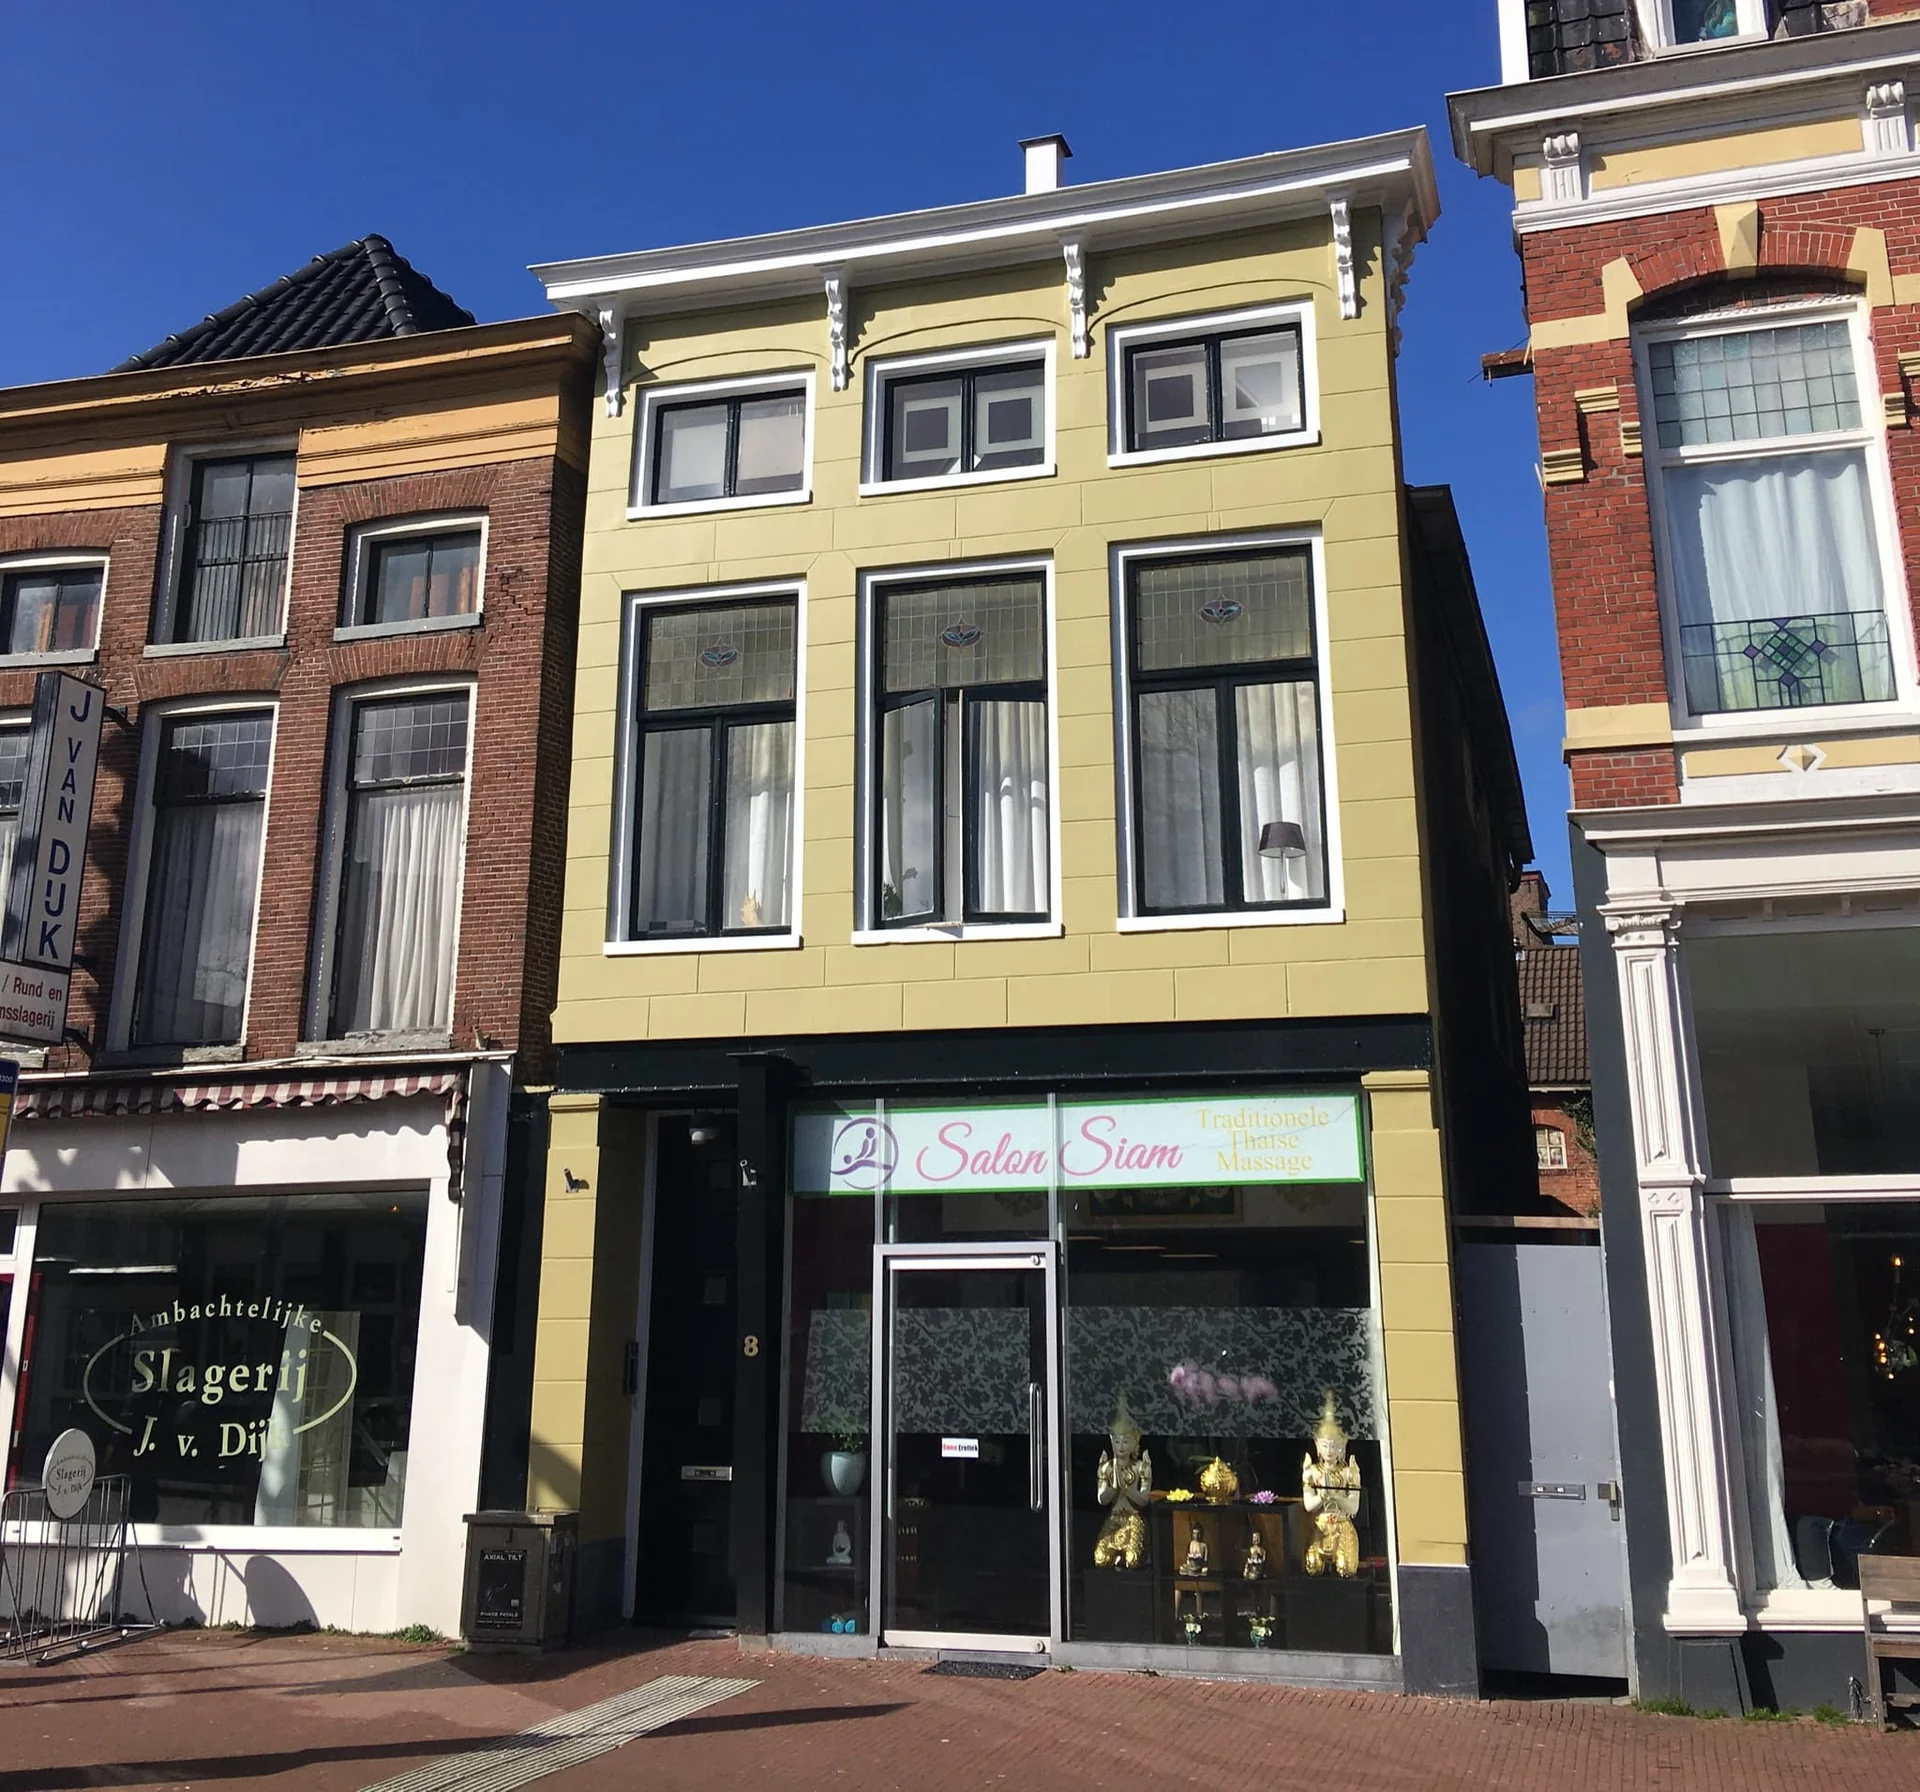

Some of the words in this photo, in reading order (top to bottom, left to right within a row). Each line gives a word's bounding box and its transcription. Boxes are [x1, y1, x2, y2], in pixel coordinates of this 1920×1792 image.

[70, 690, 91, 723] J
[57, 736, 83, 824] VAN
[38, 838, 71, 960] DIJK
[13, 976, 44, 998] Rund
[48, 987, 62, 1002] en
[1195, 1105, 1330, 1129] Traditionele
[916, 1121, 1048, 1182] Salon
[1058, 1115, 1184, 1177] Siam
[1228, 1128, 1301, 1151] Thaise
[1217, 1150, 1313, 1176] Massage
[129, 1293, 322, 1336] Ambachtelijke
[744, 1335, 758, 1357] 8
[131, 1348, 308, 1405] Slagerij
[133, 1415, 158, 1457] J.
[177, 1434, 198, 1458] v.
